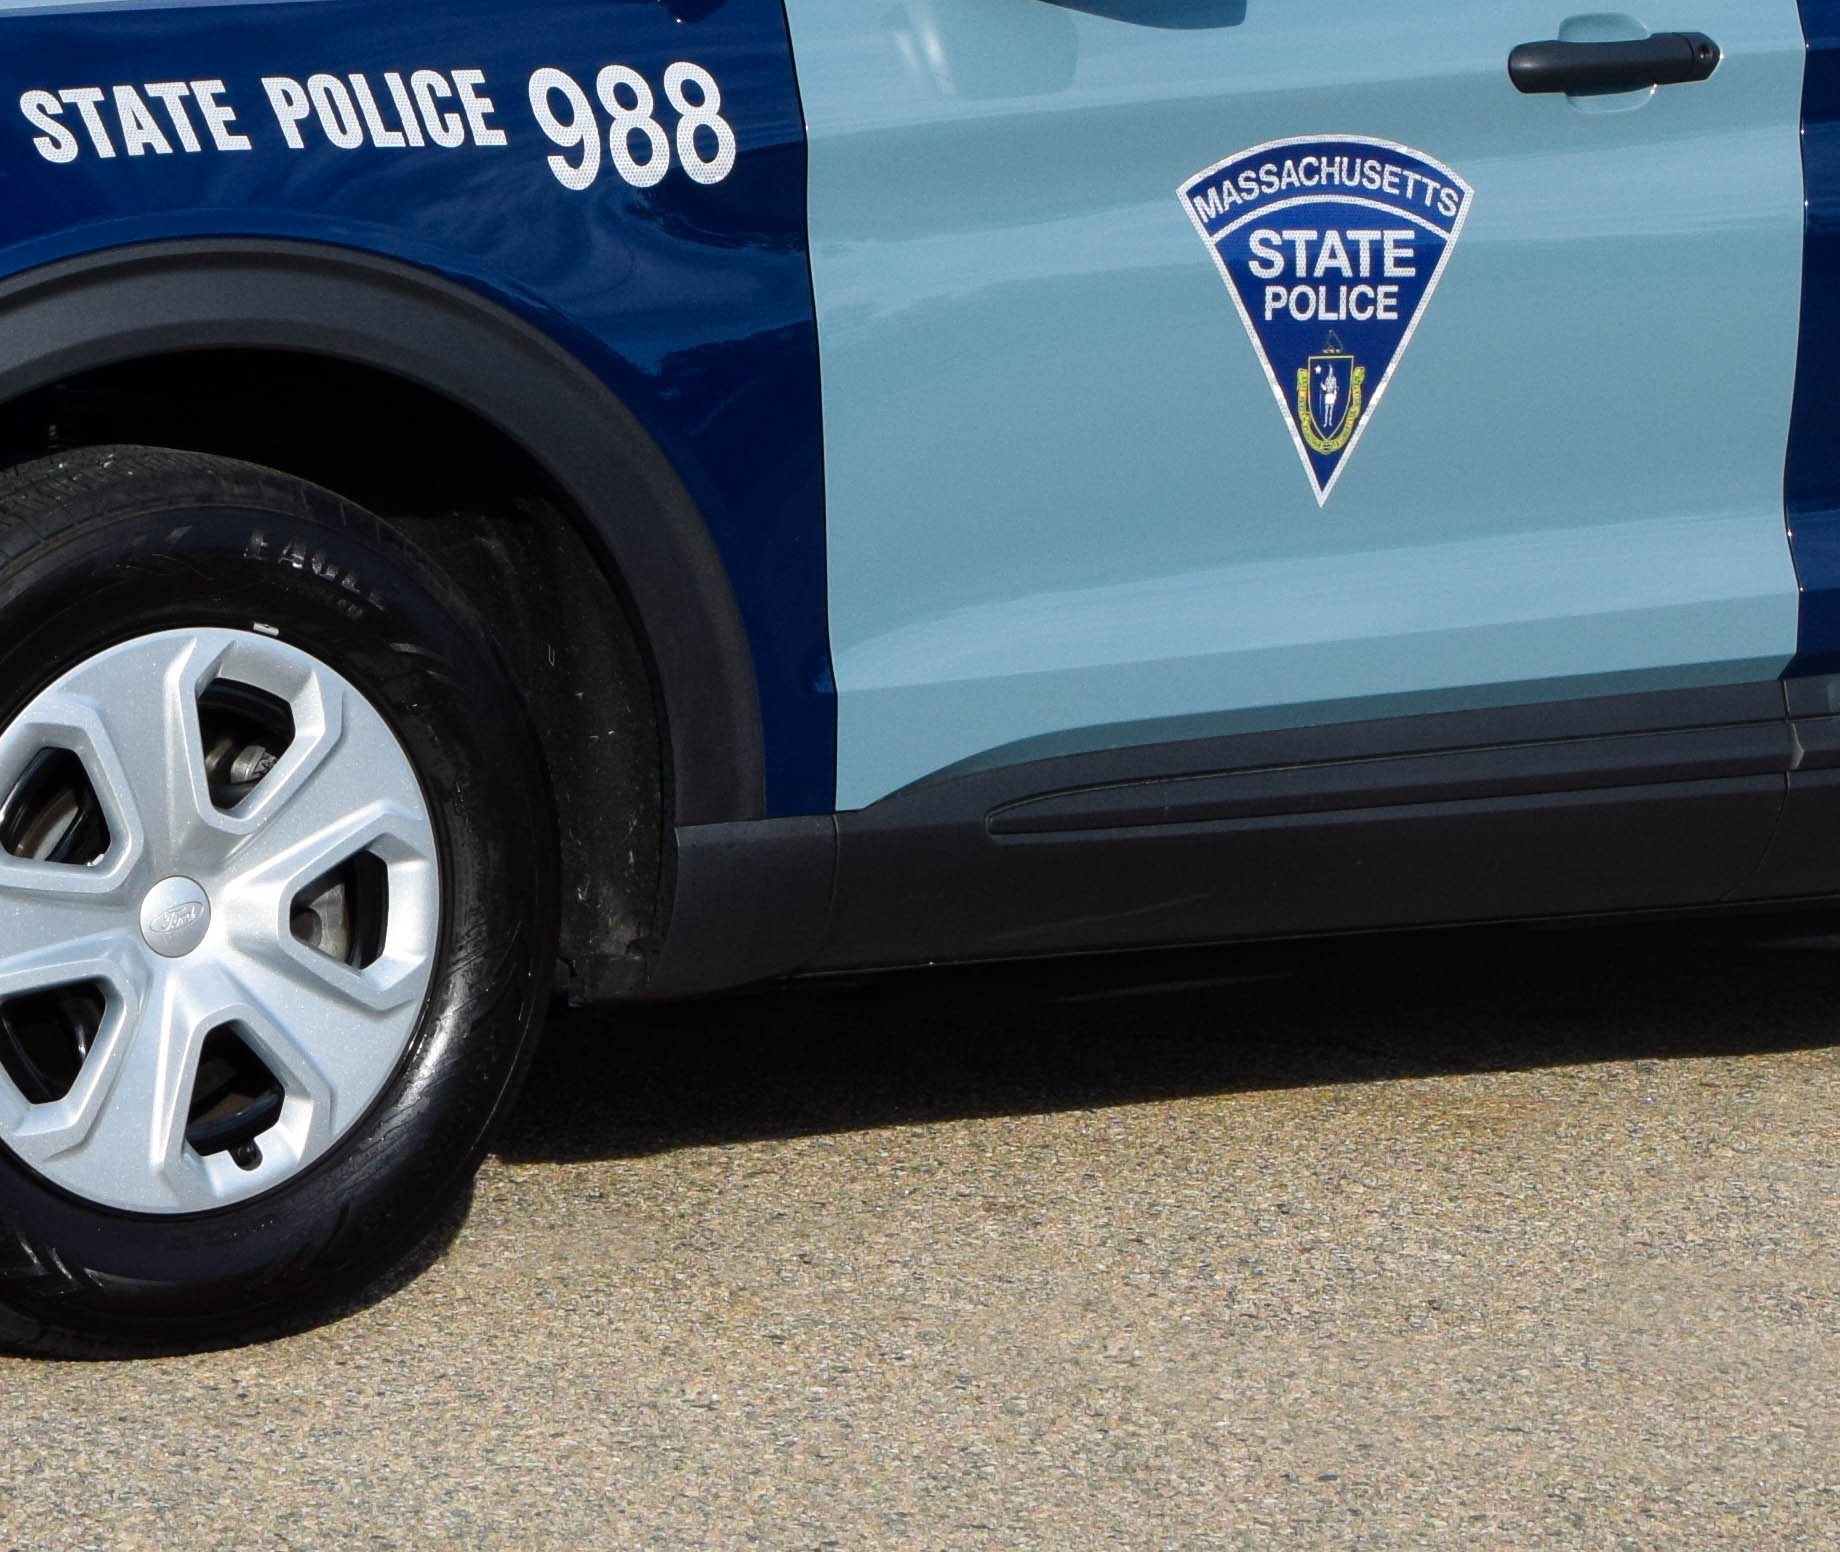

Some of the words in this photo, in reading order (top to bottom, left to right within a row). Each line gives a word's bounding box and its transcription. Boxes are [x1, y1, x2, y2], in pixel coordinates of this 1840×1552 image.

[19, 80, 253, 164] STATE
[260, 69, 508, 149] POLICE
[528, 61, 737, 191] 988
[1192, 156, 1460, 224] MASSACHUSETTS
[1248, 229, 1416, 279] STATE
[1264, 285, 1399, 321] POLICE
